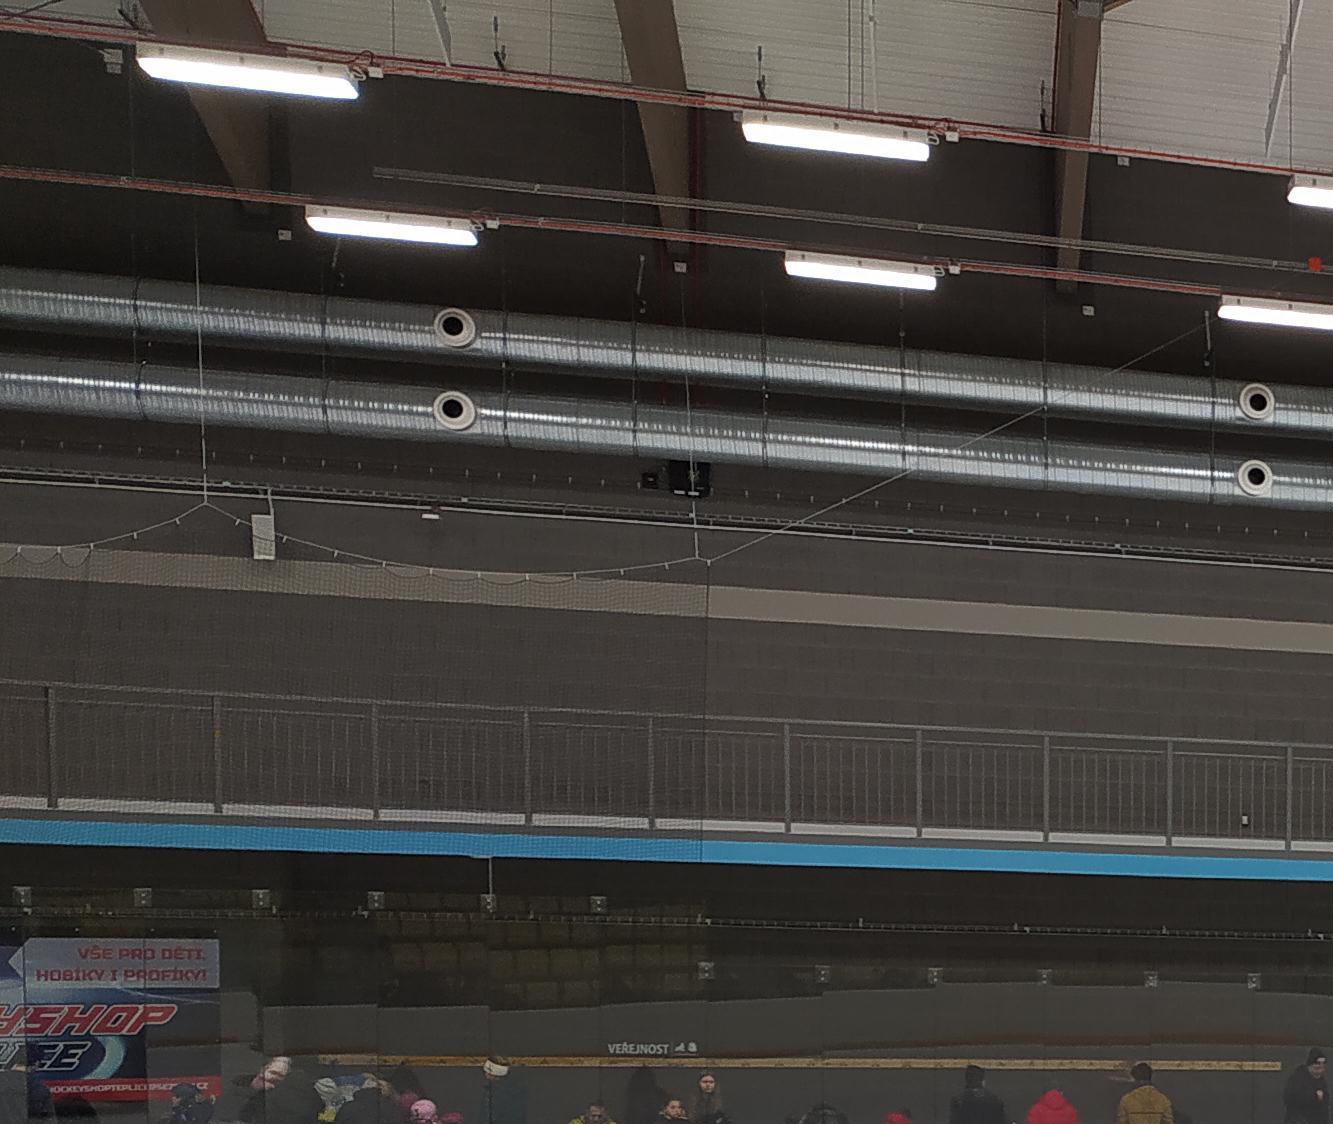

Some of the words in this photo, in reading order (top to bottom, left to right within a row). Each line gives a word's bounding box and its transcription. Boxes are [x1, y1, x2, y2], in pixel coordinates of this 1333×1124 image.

[78, 945, 113, 960] VŠE
[119, 948, 155, 960] PRO
[608, 1042, 669, 1054] VEŘEJNOST
